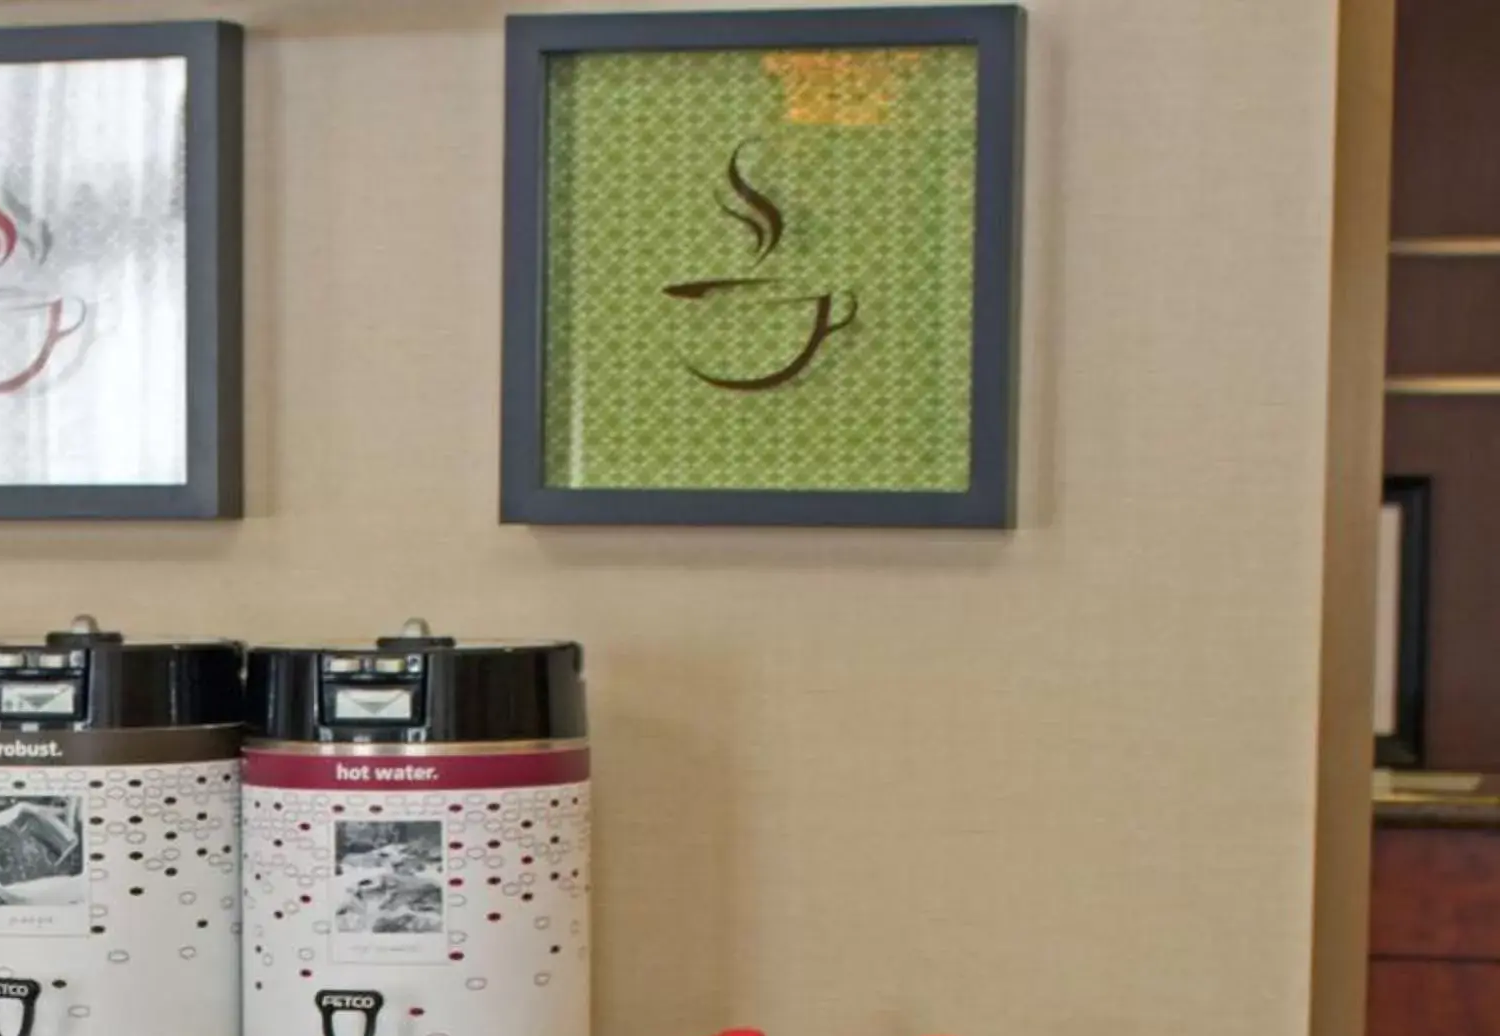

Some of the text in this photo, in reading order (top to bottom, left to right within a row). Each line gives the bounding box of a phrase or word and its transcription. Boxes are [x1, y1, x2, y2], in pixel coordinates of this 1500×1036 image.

[337, 762, 439, 780] hot water.
[322, 995, 375, 1009] FETCO
